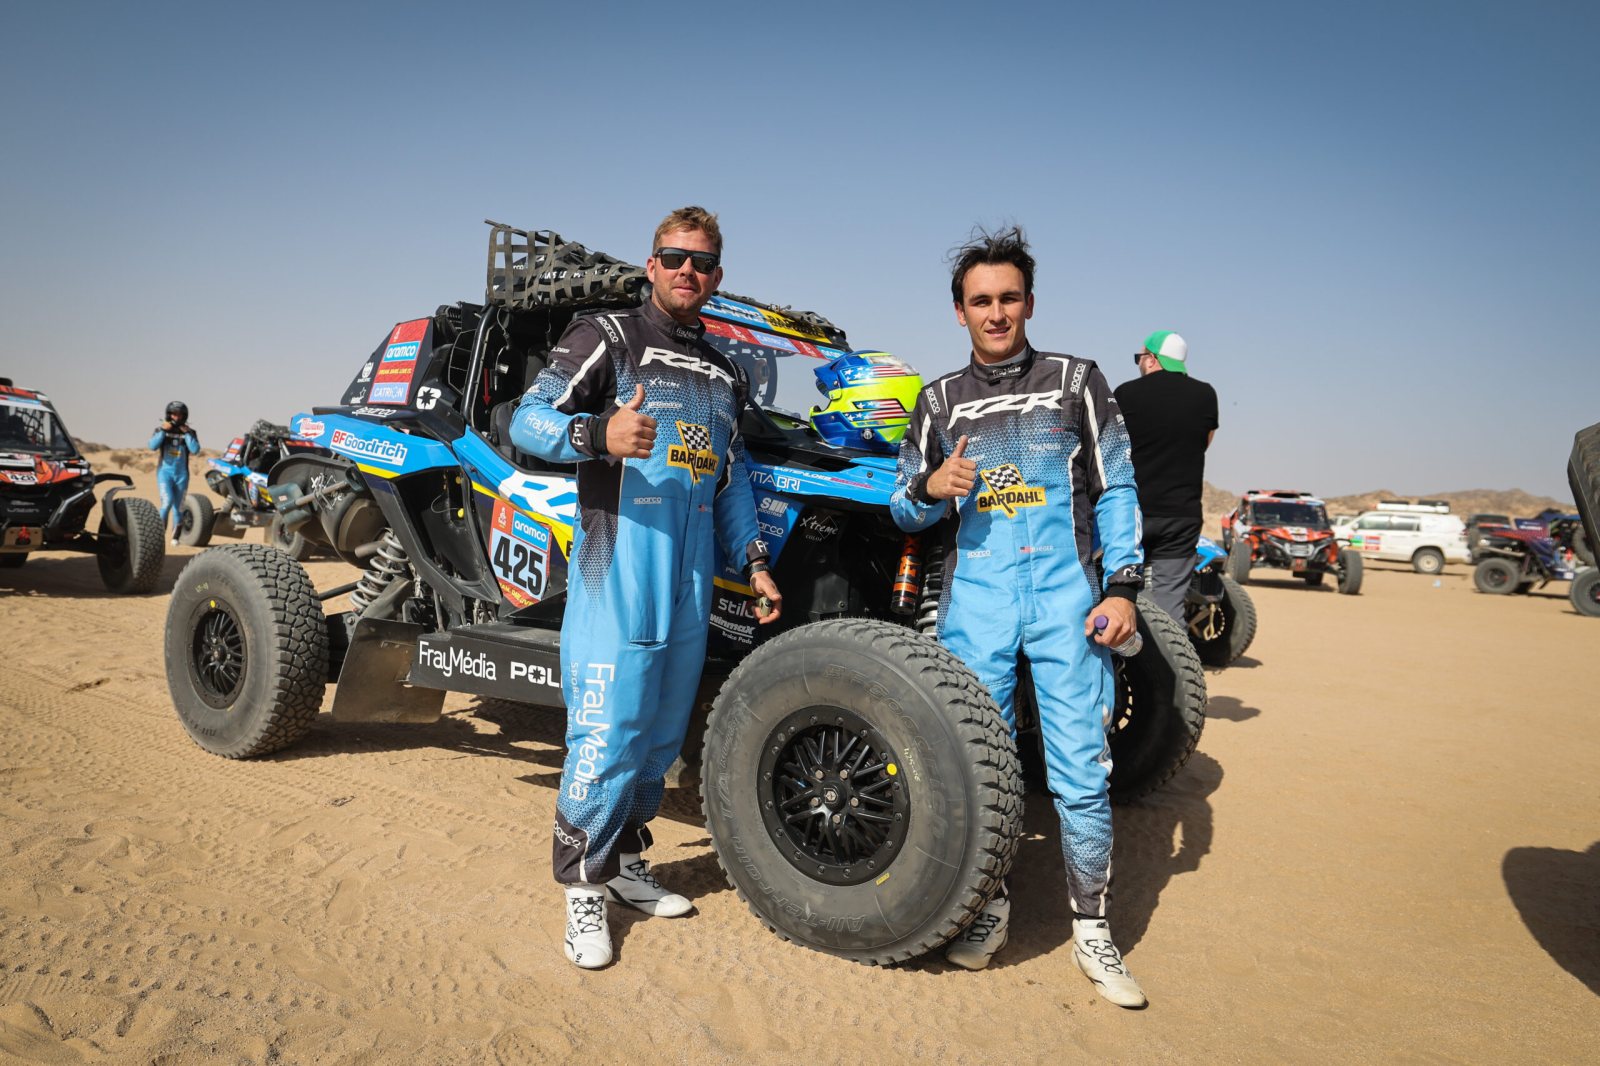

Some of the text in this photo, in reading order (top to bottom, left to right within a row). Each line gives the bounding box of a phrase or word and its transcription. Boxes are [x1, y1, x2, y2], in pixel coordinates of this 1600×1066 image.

[595, 316, 619, 343] sparco
[386, 345, 416, 358] aramco
[640, 346, 735, 389] RZR
[1070, 363, 1086, 394] sparco
[925, 387, 941, 414] sparco
[947, 389, 1064, 431] RZR
[332, 430, 406, 459] BFGoodrich
[670, 449, 717, 472] BARDAHL
[634, 497, 661, 505] sparco
[978, 491, 1043, 508] BARDAHL
[514, 521, 547, 543] aramco
[494, 535, 543, 596] 425
[722, 630, 753, 645] Brake Pads
[419, 640, 497, 681] FrayMédia
[511, 661, 563, 689] POL
[571, 661, 579, 702] SPORT
[568, 662, 616, 801] FrayMédia
